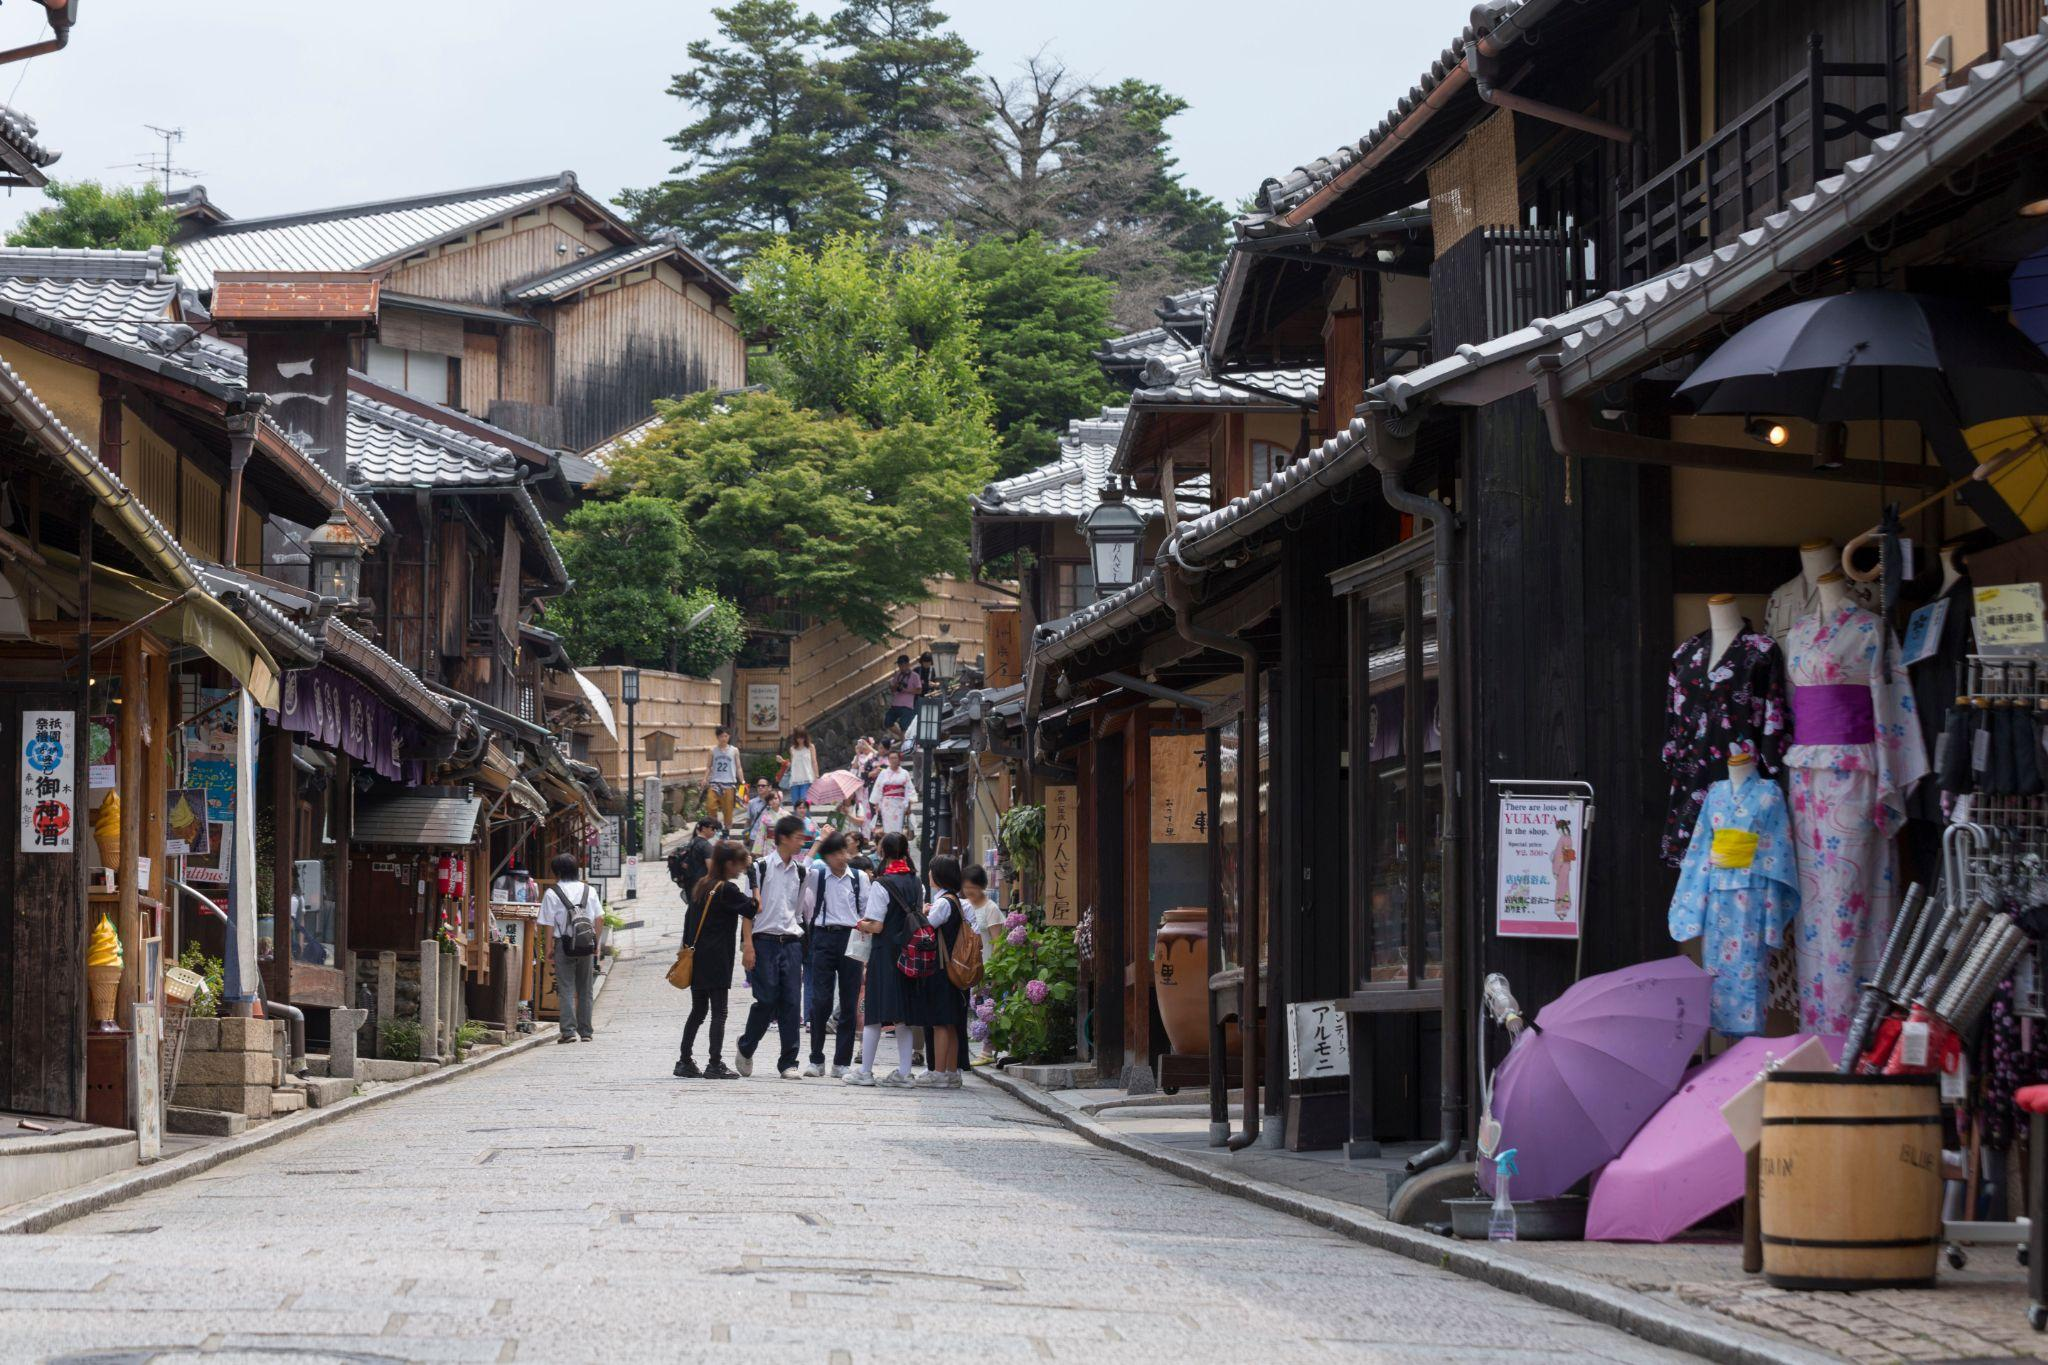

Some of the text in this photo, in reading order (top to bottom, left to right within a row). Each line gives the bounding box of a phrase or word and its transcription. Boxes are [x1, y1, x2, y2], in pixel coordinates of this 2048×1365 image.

[717, 762, 728, 772] 22
[1505, 803, 1526, 811] There
[1504, 813, 1557, 824] YUKATA
[1529, 828, 1549, 836] shop.
[1052, 822, 1070, 921] かんざし屋
[1312, 1006, 1334, 1071] アルモニ
[1335, 1013, 1347, 1055] ンティーク
[1899, 1143, 1935, 1171] BLUE
